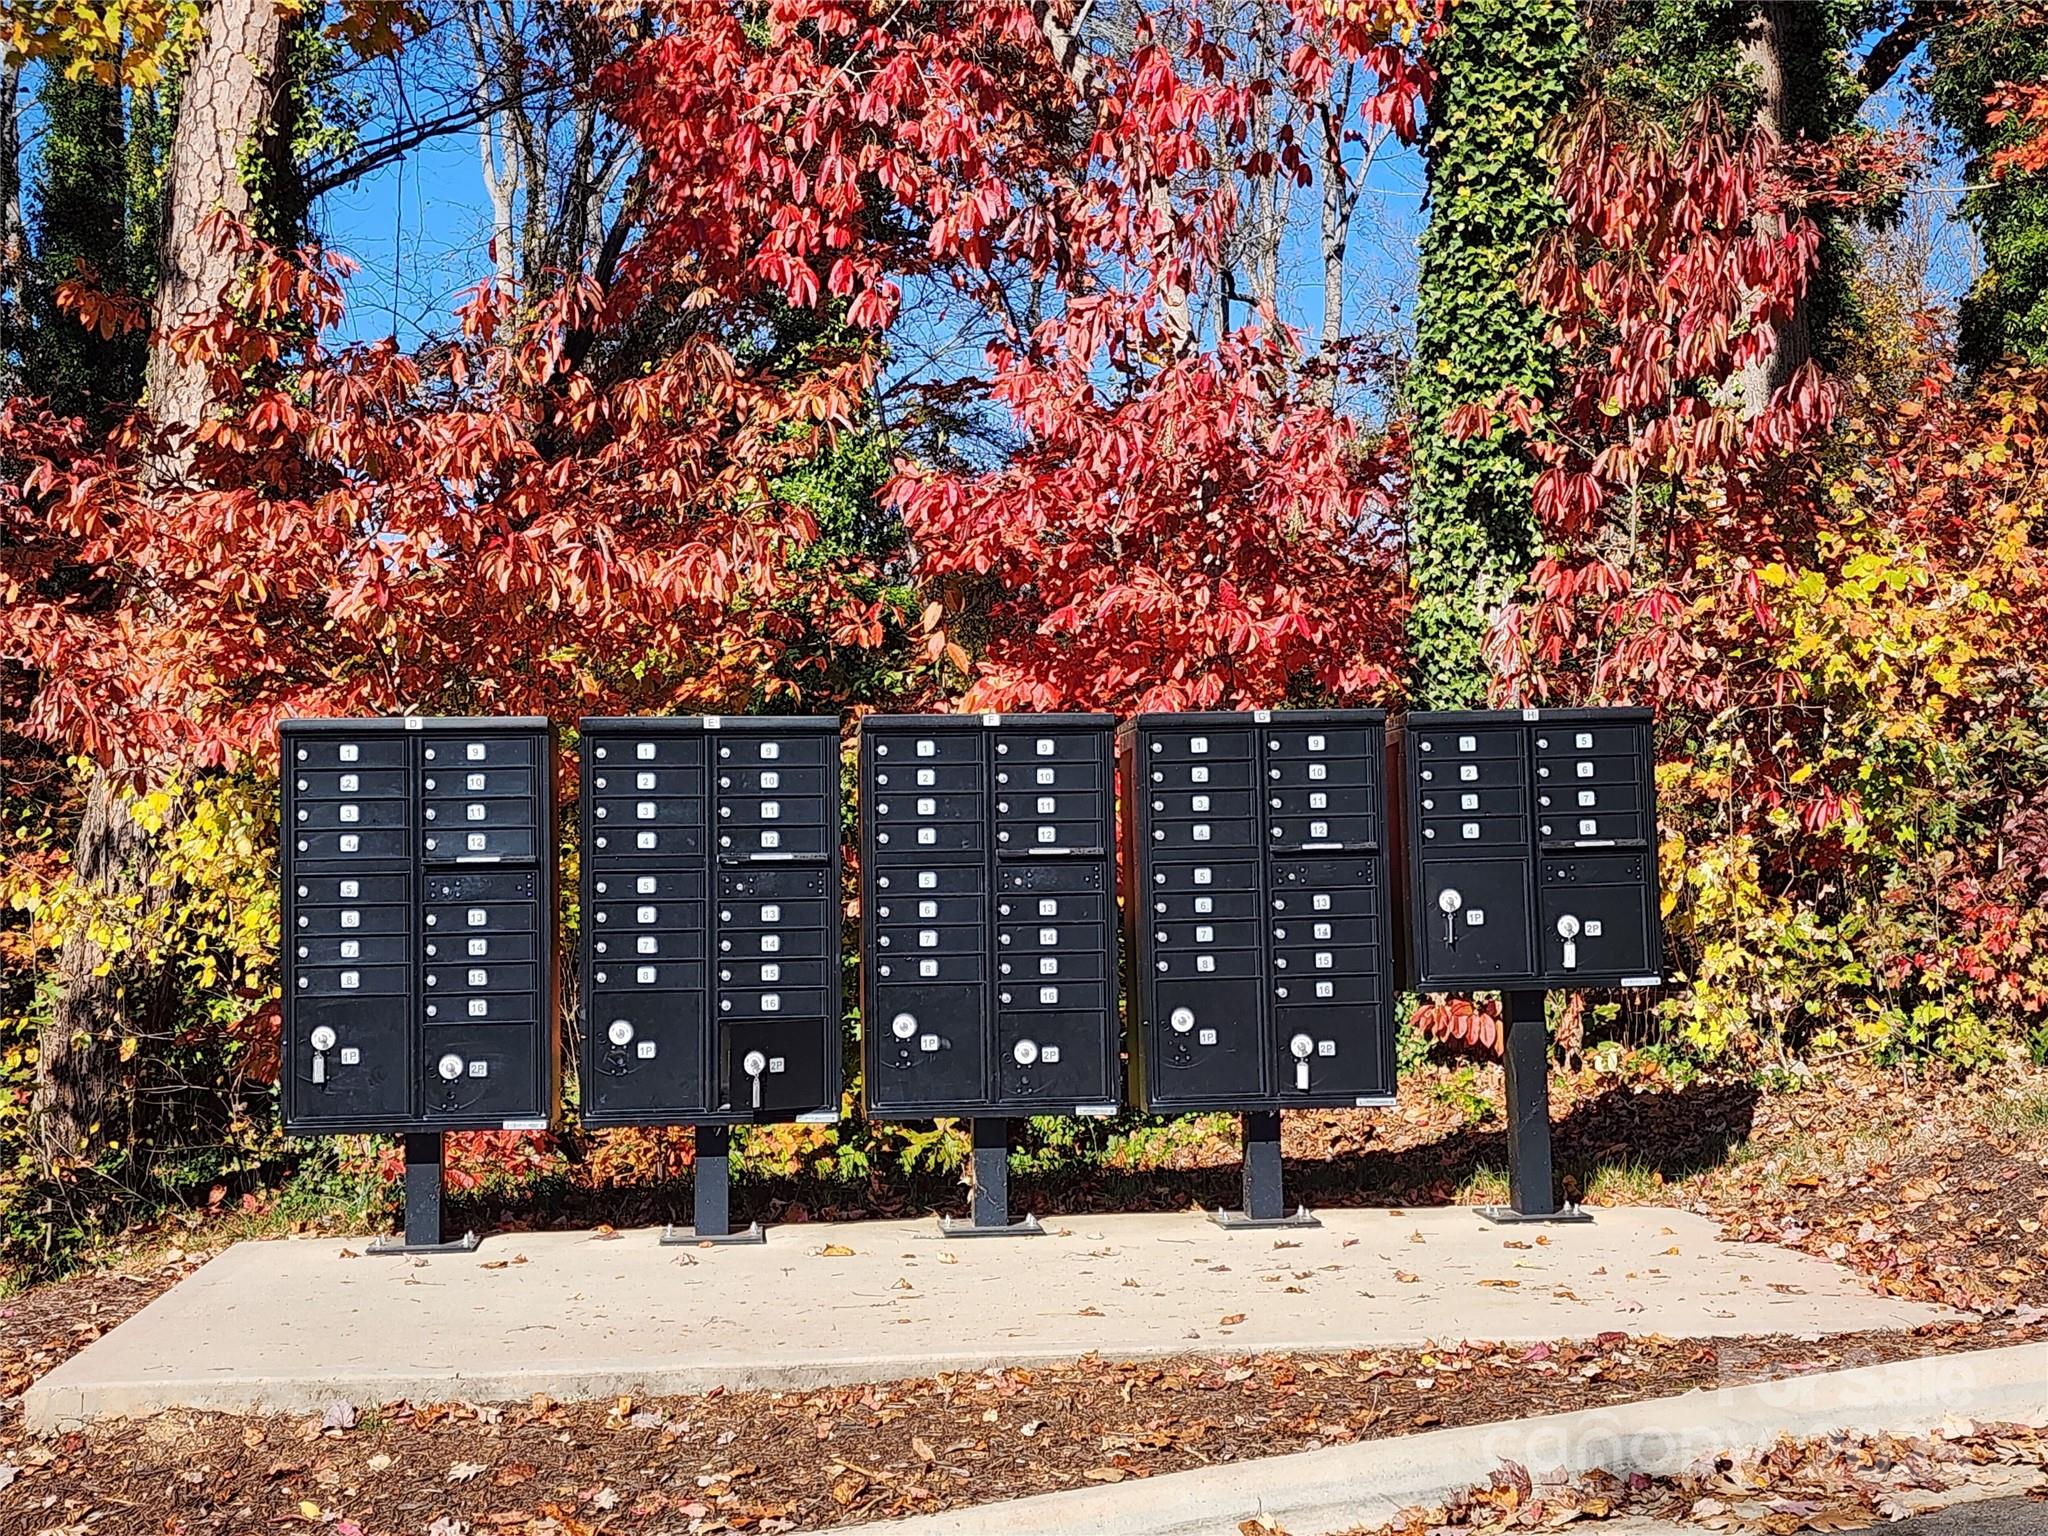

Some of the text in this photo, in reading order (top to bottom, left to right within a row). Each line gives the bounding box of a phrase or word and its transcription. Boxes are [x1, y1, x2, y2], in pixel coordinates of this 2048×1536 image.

[988, 715, 995, 724] F
[1258, 712, 1266, 721] G
[1527, 711, 1535, 719] H
[409, 719, 417, 728] D
[708, 718, 715, 727] E
[1040, 772, 1051, 781] 10
[1312, 767, 1323, 777] 10
[470, 778, 482, 788] 10
[764, 776, 775, 786] 10
[1040, 802, 1051, 810] 11
[1312, 797, 1323, 806] 11
[470, 807, 481, 817] 11
[764, 806, 775, 815] 11
[1041, 830, 1052, 840] 12
[1314, 825, 1325, 835] 12
[471, 837, 483, 848] 12
[764, 835, 776, 845] 12
[1316, 898, 1328, 908] 13
[1042, 904, 1053, 913] 13
[471, 913, 483, 923] 13
[764, 909, 776, 919] 13
[1469, 913, 1482, 922] 1P
[1317, 927, 1329, 937] 14
[1586, 924, 1600, 934] 2P
[1043, 933, 1054, 942] 14
[471, 943, 483, 952] 14
[764, 939, 776, 949] 14
[1318, 956, 1330, 966] 15
[1043, 962, 1055, 972] 15
[472, 973, 484, 983] 15
[764, 969, 776, 978] 15
[1319, 985, 1331, 995] 16
[1043, 991, 1055, 1001] 16
[472, 1003, 484, 1013] 16
[764, 999, 776, 1008] 16
[1202, 1032, 1214, 1042] 1P
[923, 1038, 936, 1048] 1P
[640, 1046, 653, 1056] 1P
[1320, 1044, 1333, 1054] 2P
[344, 1051, 357, 1063] 1P
[1043, 1050, 1057, 1060] 2P
[470, 1064, 485, 1074] 2P
[771, 1060, 783, 1071] 2P
